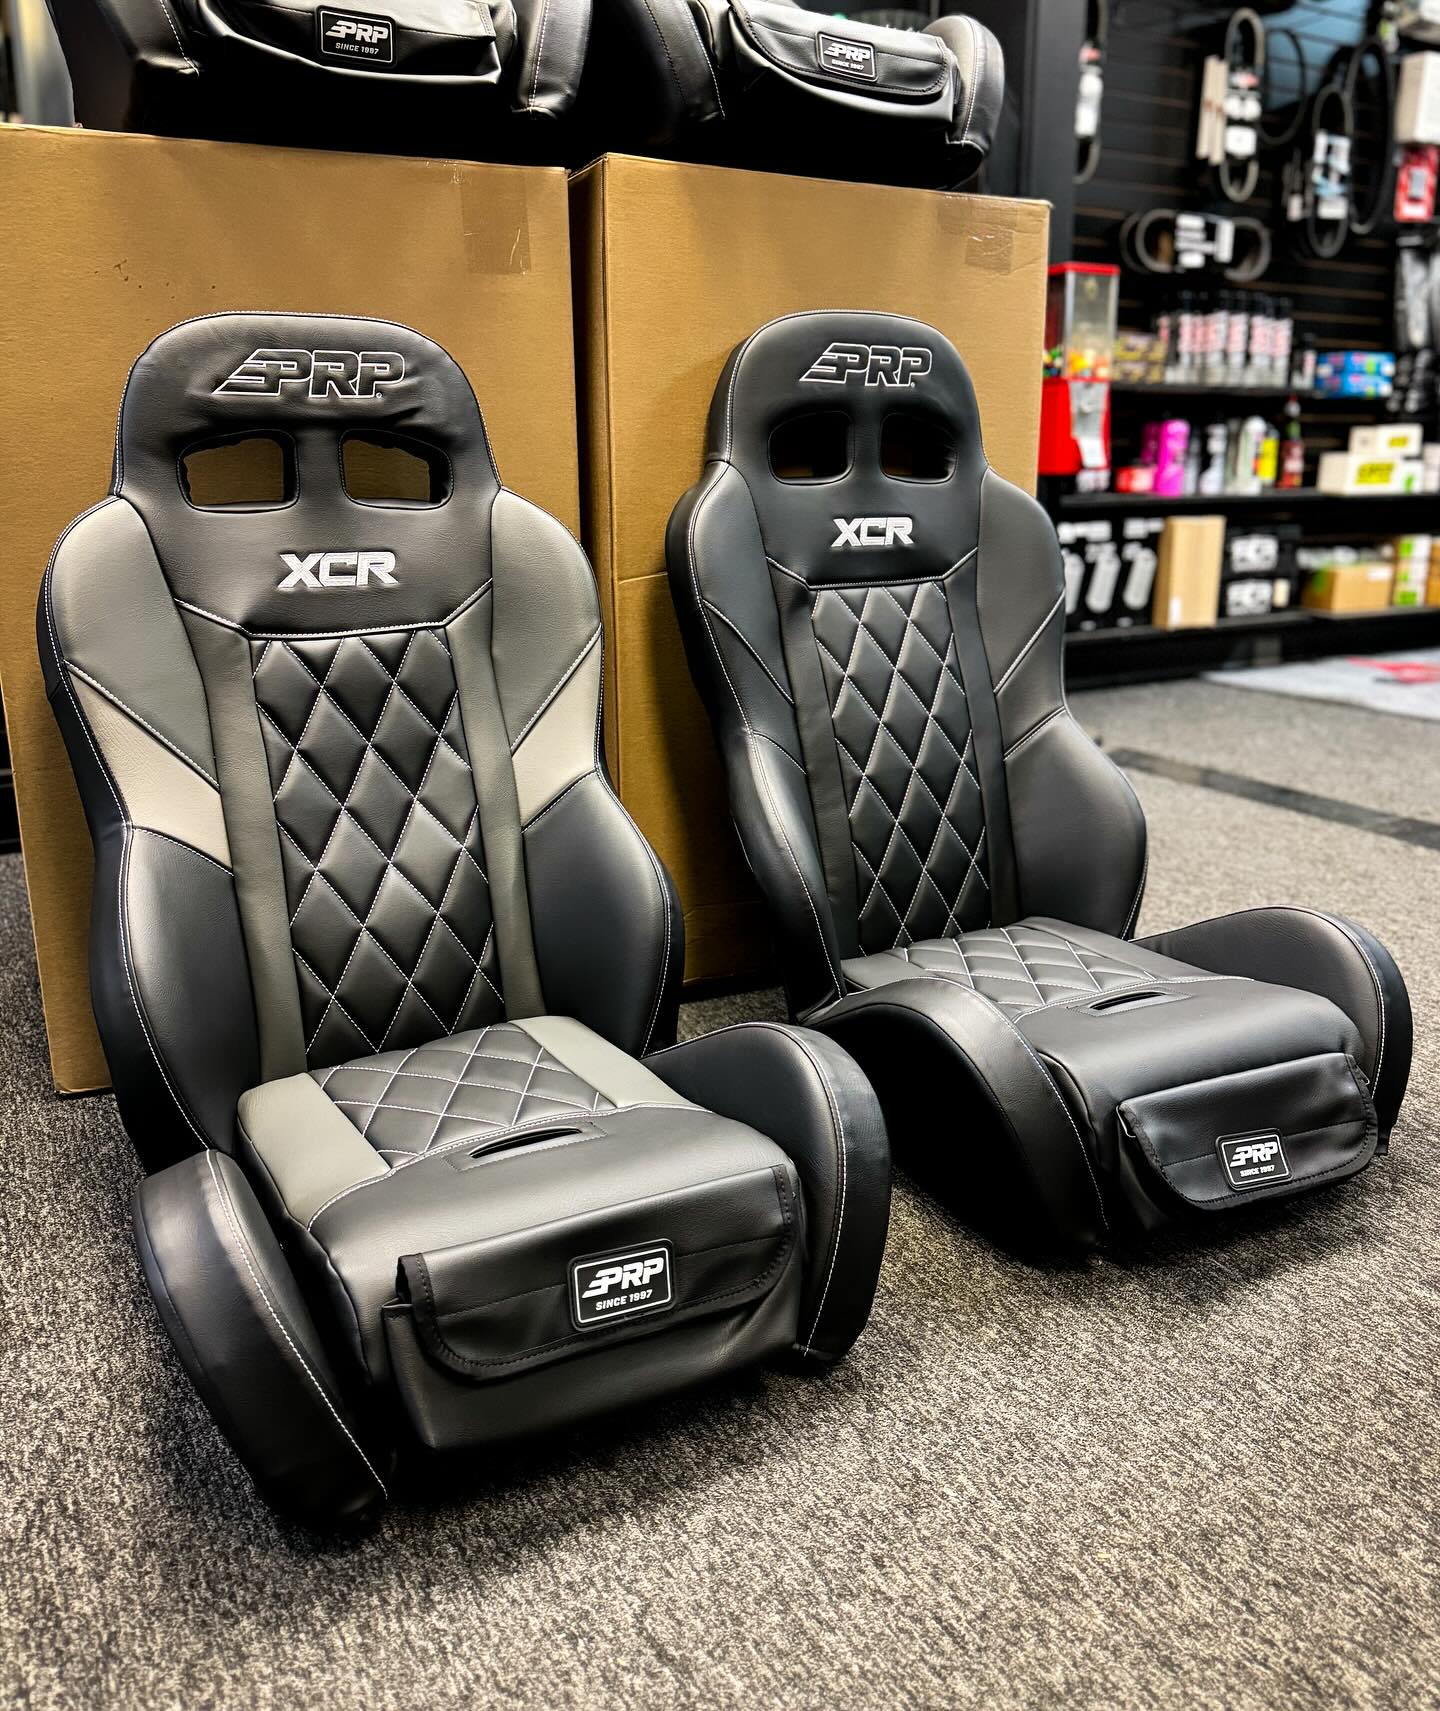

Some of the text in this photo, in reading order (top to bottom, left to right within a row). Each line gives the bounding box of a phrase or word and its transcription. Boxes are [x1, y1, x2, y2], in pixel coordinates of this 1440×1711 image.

[325, 20, 389, 43] PRP
[335, 42, 379, 54] SINCE 1997
[823, 42, 871, 62] PRP
[831, 516, 914, 547] XCR
[277, 551, 399, 588] XCR
[1229, 1141, 1279, 1168] PRP
[1240, 1167, 1260, 1177] SINCE
[581, 1257, 664, 1299] PRP
[595, 1289, 653, 1311] SINCE 1997
